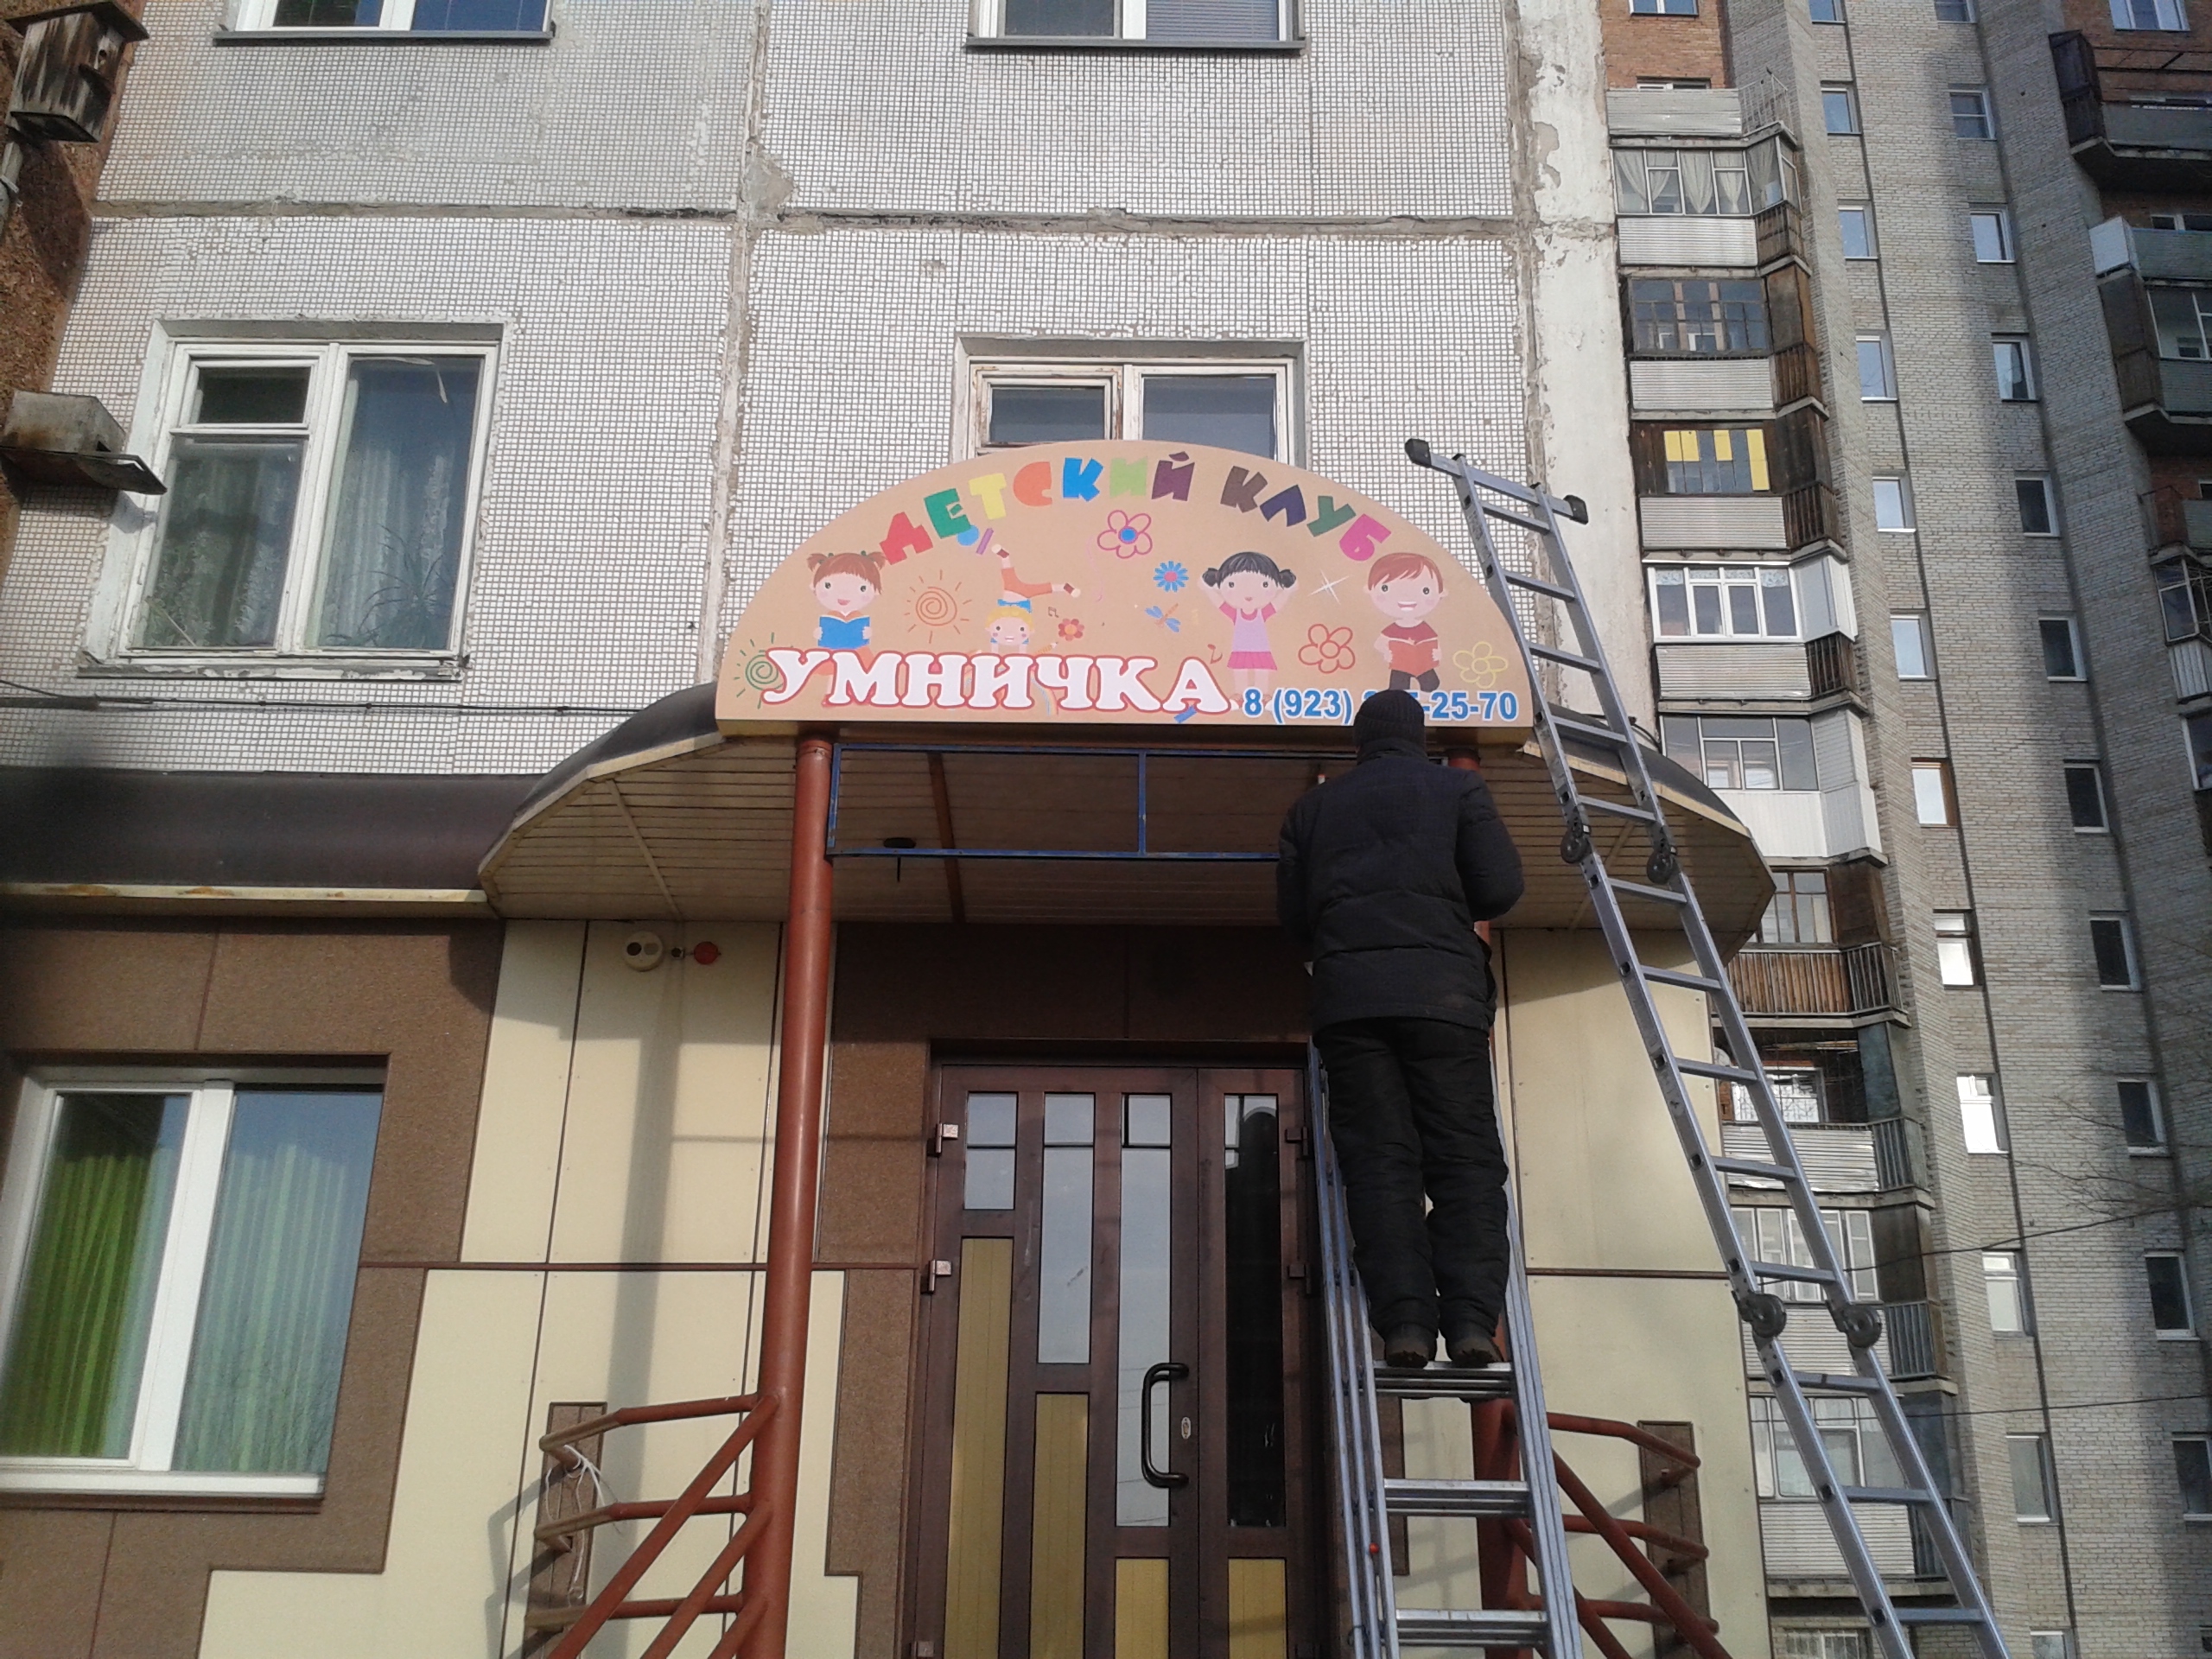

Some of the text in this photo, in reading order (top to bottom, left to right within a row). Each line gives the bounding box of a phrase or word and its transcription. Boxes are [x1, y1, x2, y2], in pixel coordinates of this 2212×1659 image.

[880, 451, 1196, 565] ДЕТСКИЙ
[1220, 465, 1391, 562] КЛУБ
[762, 648, 1232, 715] УМНИЧКА
[1243, 688, 1518, 726] 8 (923) -25-70
